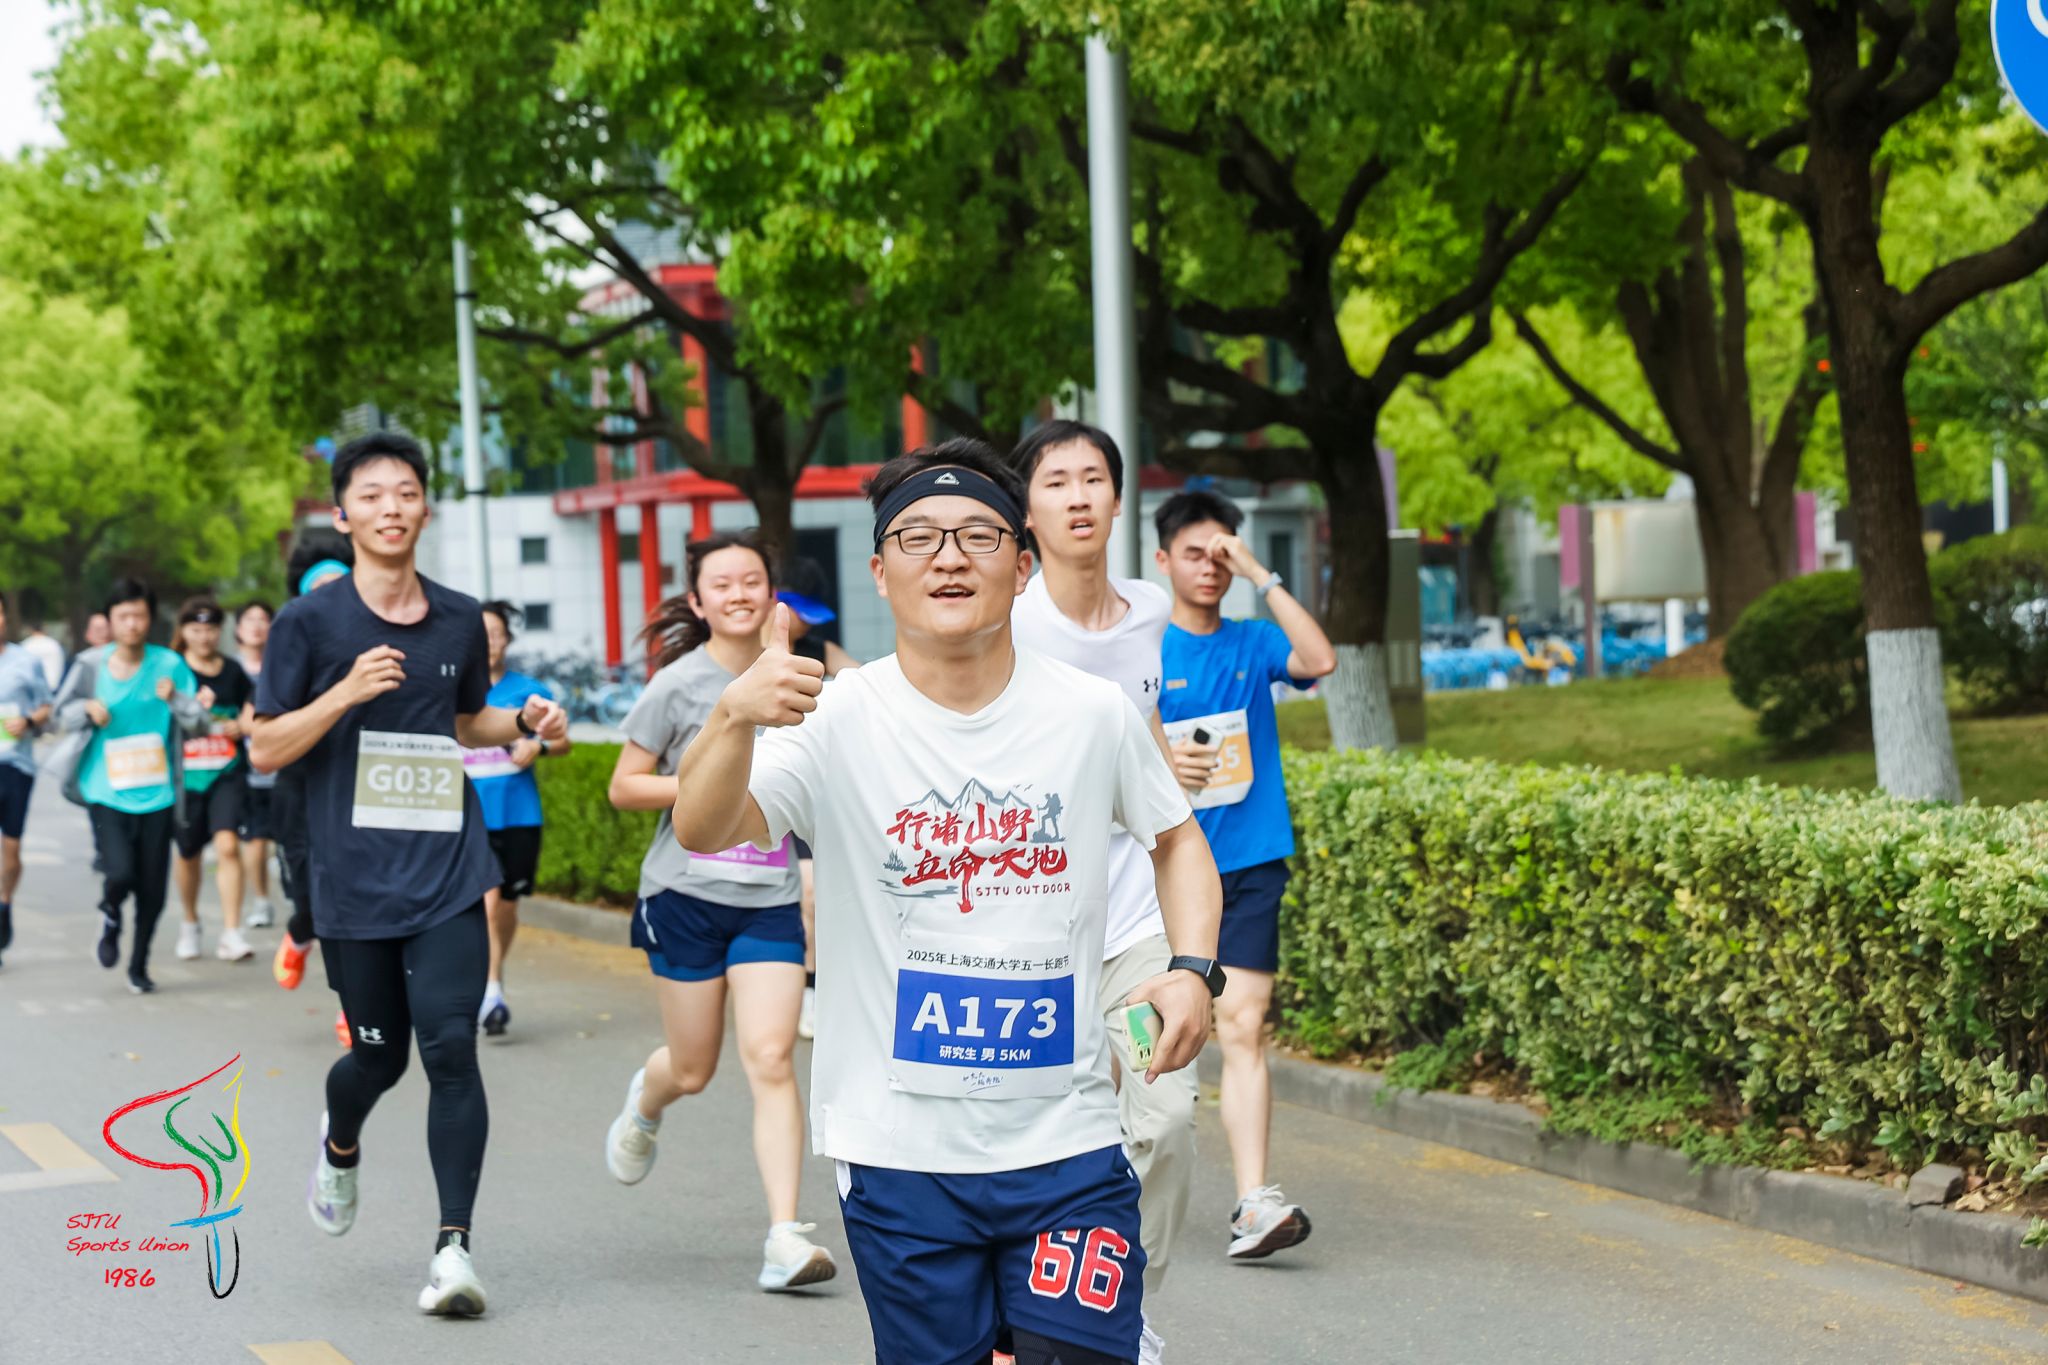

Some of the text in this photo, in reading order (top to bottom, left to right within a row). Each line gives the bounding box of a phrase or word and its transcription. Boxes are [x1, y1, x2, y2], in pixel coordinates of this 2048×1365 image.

[367, 763, 453, 796] G032
[886, 802, 1035, 851] 行诸山野
[901, 845, 1068, 912] 立命天地
[976, 882, 1071, 897] SJTU OUTDOOR
[906, 949, 1070, 972] 2025年上海交通大学五一长跑节
[911, 991, 1058, 1039] A173
[939, 1045, 1031, 1062] 研究生 男 5KM
[1028, 1226, 1131, 1313] 66
